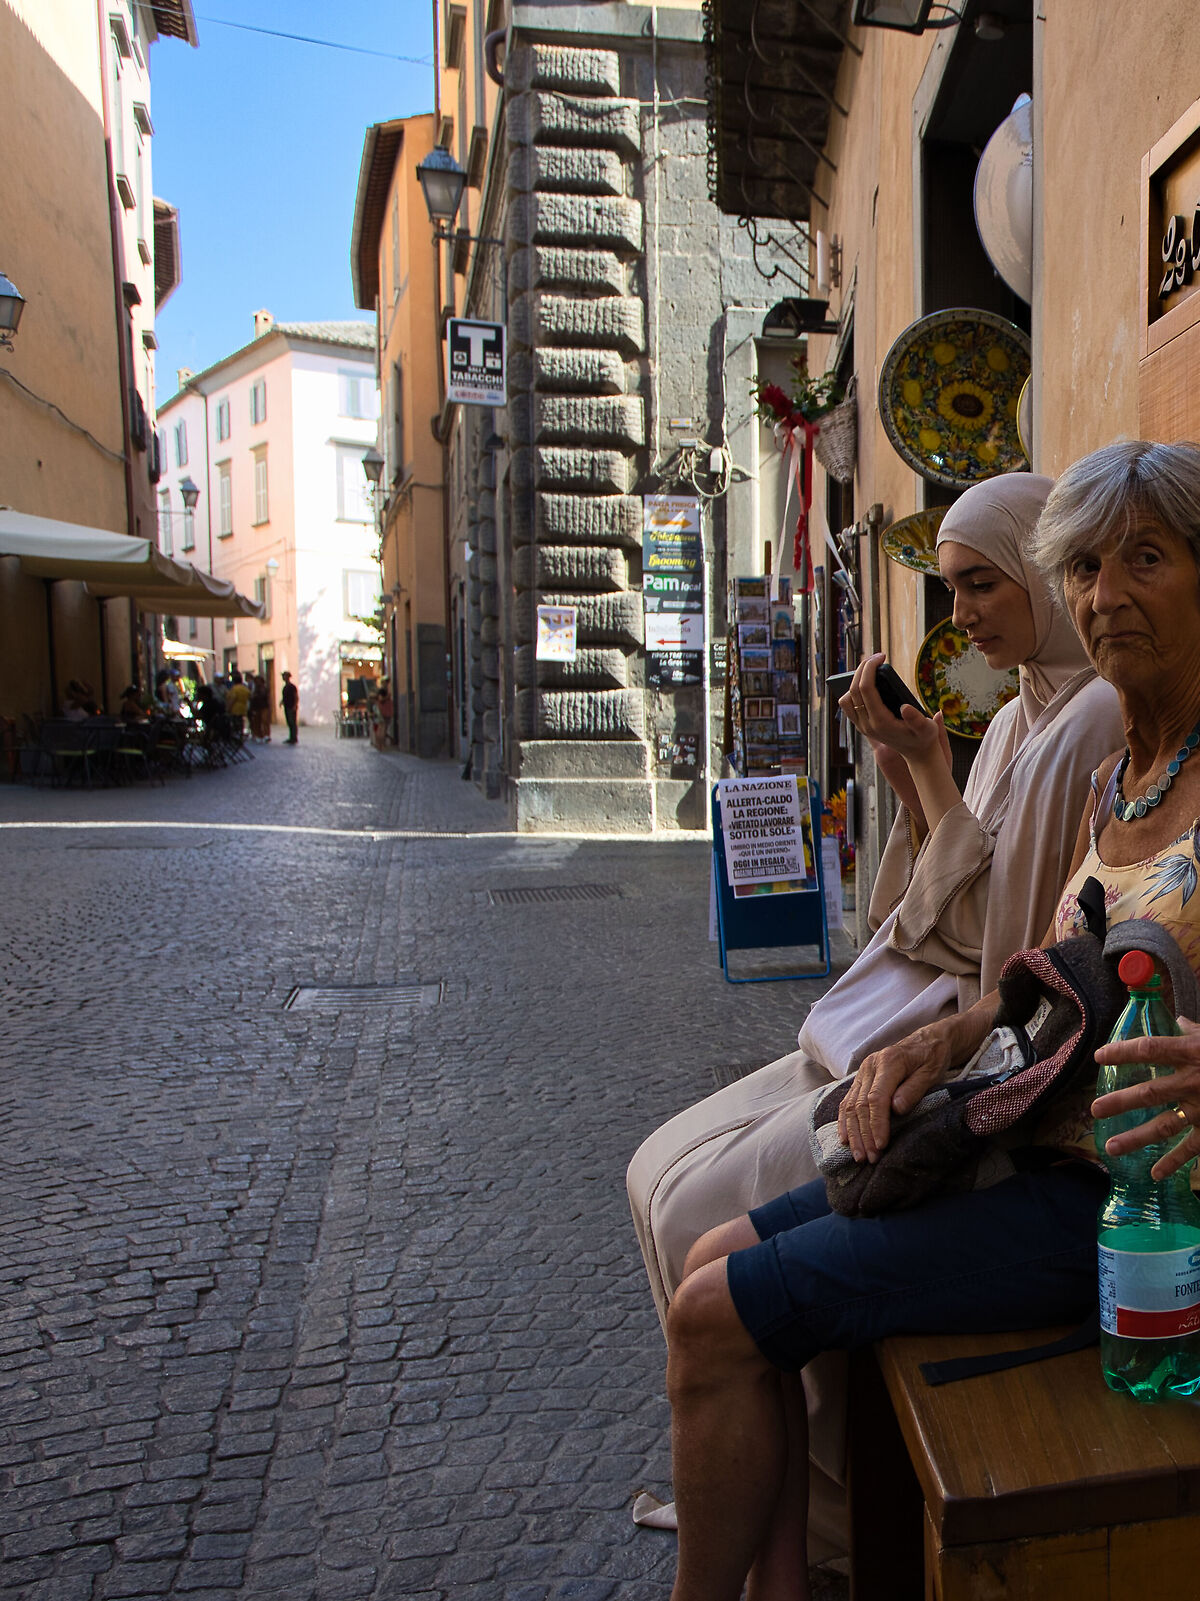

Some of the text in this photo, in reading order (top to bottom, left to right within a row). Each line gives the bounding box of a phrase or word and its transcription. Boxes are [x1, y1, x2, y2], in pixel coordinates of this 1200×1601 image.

[458, 325, 496, 367] T
[451, 371, 503, 384] TABACCHI
[643, 574, 702, 591] Pam local
[741, 780, 792, 792] NAZIONE
[726, 794, 793, 808] ALLERTA-CALDO
[733, 806, 788, 818] LA REGIONE:
[729, 816, 795, 830] «VIETATO LAVORARE
[729, 827, 795, 840] SOTTO IL SOLE»
[775, 839, 797, 847] ORIENTE
[733, 856, 785, 868] OGGI IN REGALO
[1175, 1279, 1200, 1297] FONTE
